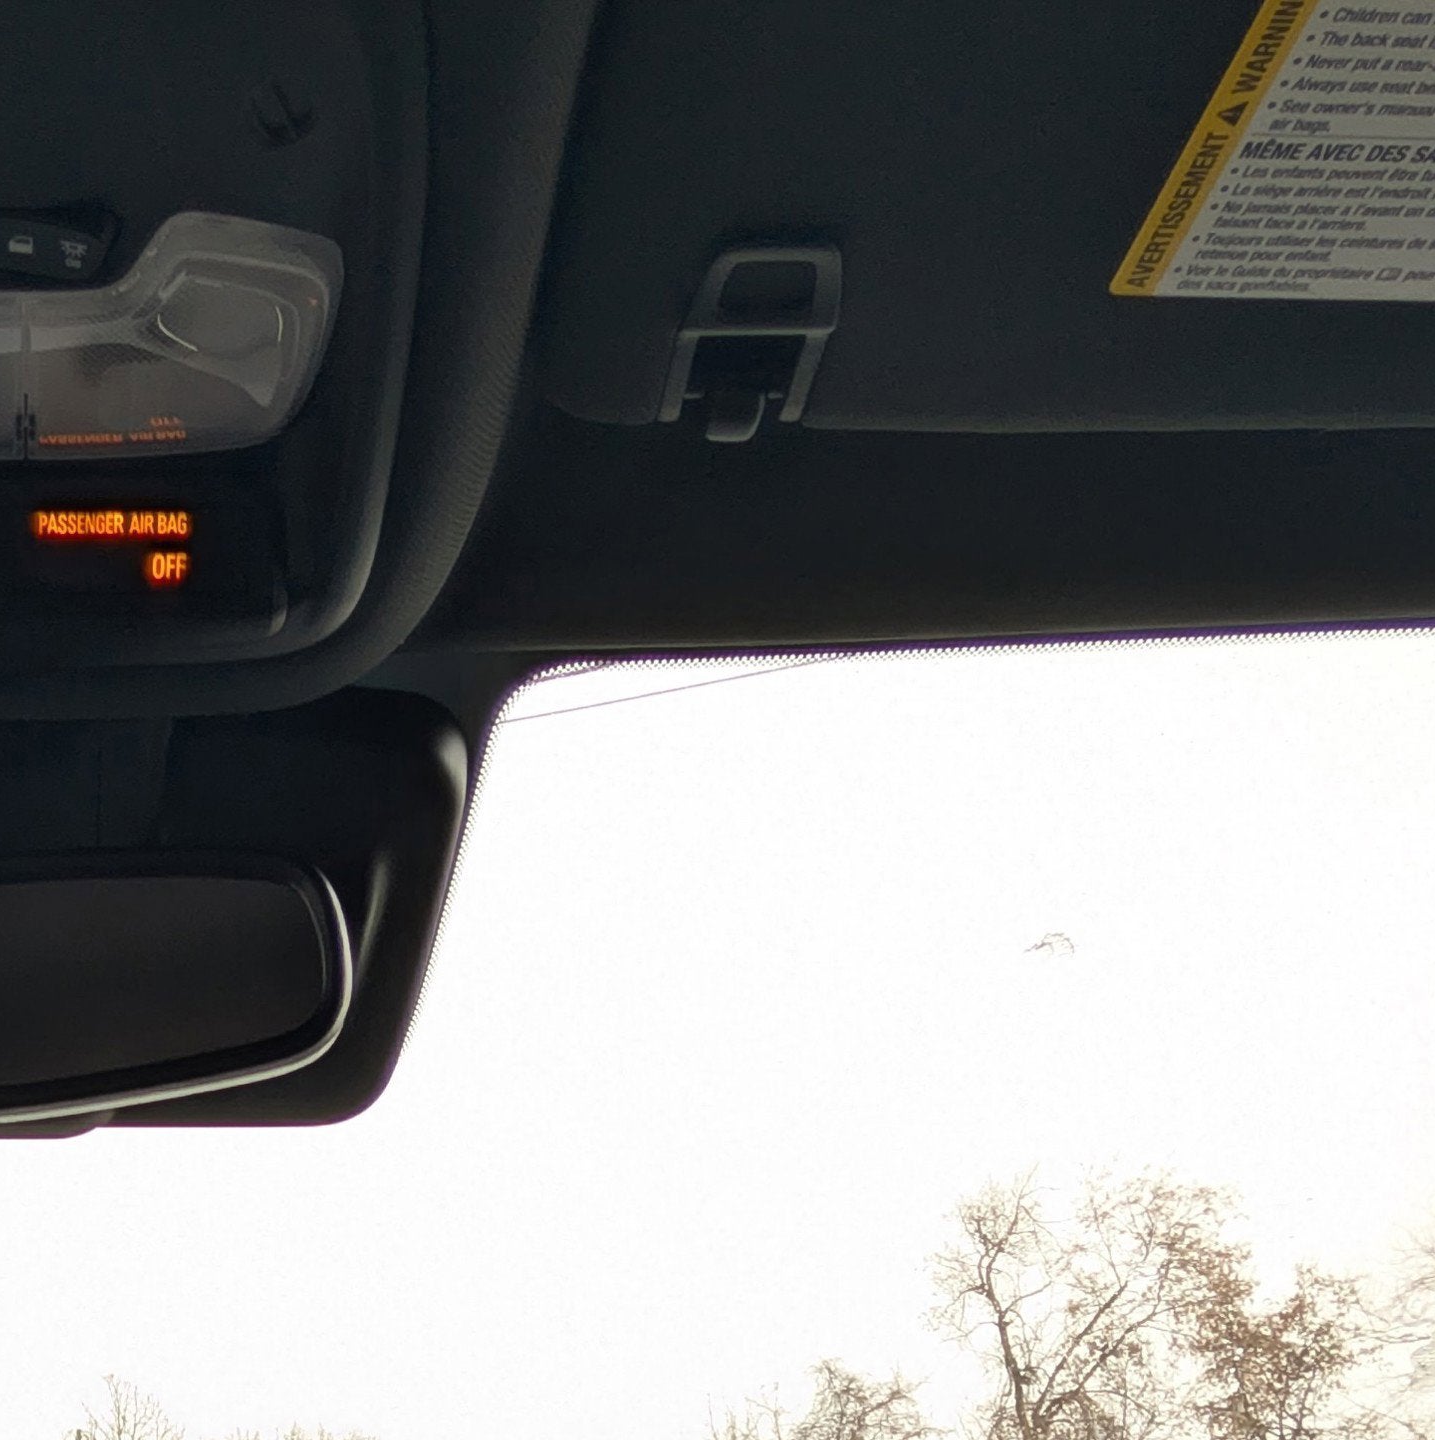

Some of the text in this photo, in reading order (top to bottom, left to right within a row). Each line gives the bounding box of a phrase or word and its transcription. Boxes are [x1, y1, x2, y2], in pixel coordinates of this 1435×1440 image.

[1333, 7, 1399, 24] Children
[1401, 11, 1433, 25] can
[1234, 0, 1304, 96] WARNIN
[1320, 31, 1349, 47] The
[1350, 32, 1390, 47] back
[1391, 34, 1427, 48] seat
[1304, 54, 1350, 70] Never
[1350, 56, 1381, 73] put
[1380, 58, 1394, 71] a
[1291, 77, 1347, 94] Always
[1348, 80, 1378, 93] use
[1379, 80, 1414, 94] seat
[1239, 139, 1304, 160] MÊME
[1306, 143, 1363, 161] AVEC
[1365, 144, 1409, 163] DES
[1127, 132, 1231, 288] AVERTISSEMENT
[38, 511, 188, 535] PASSENGER AIR BAG
[152, 550, 188, 580] OFF
